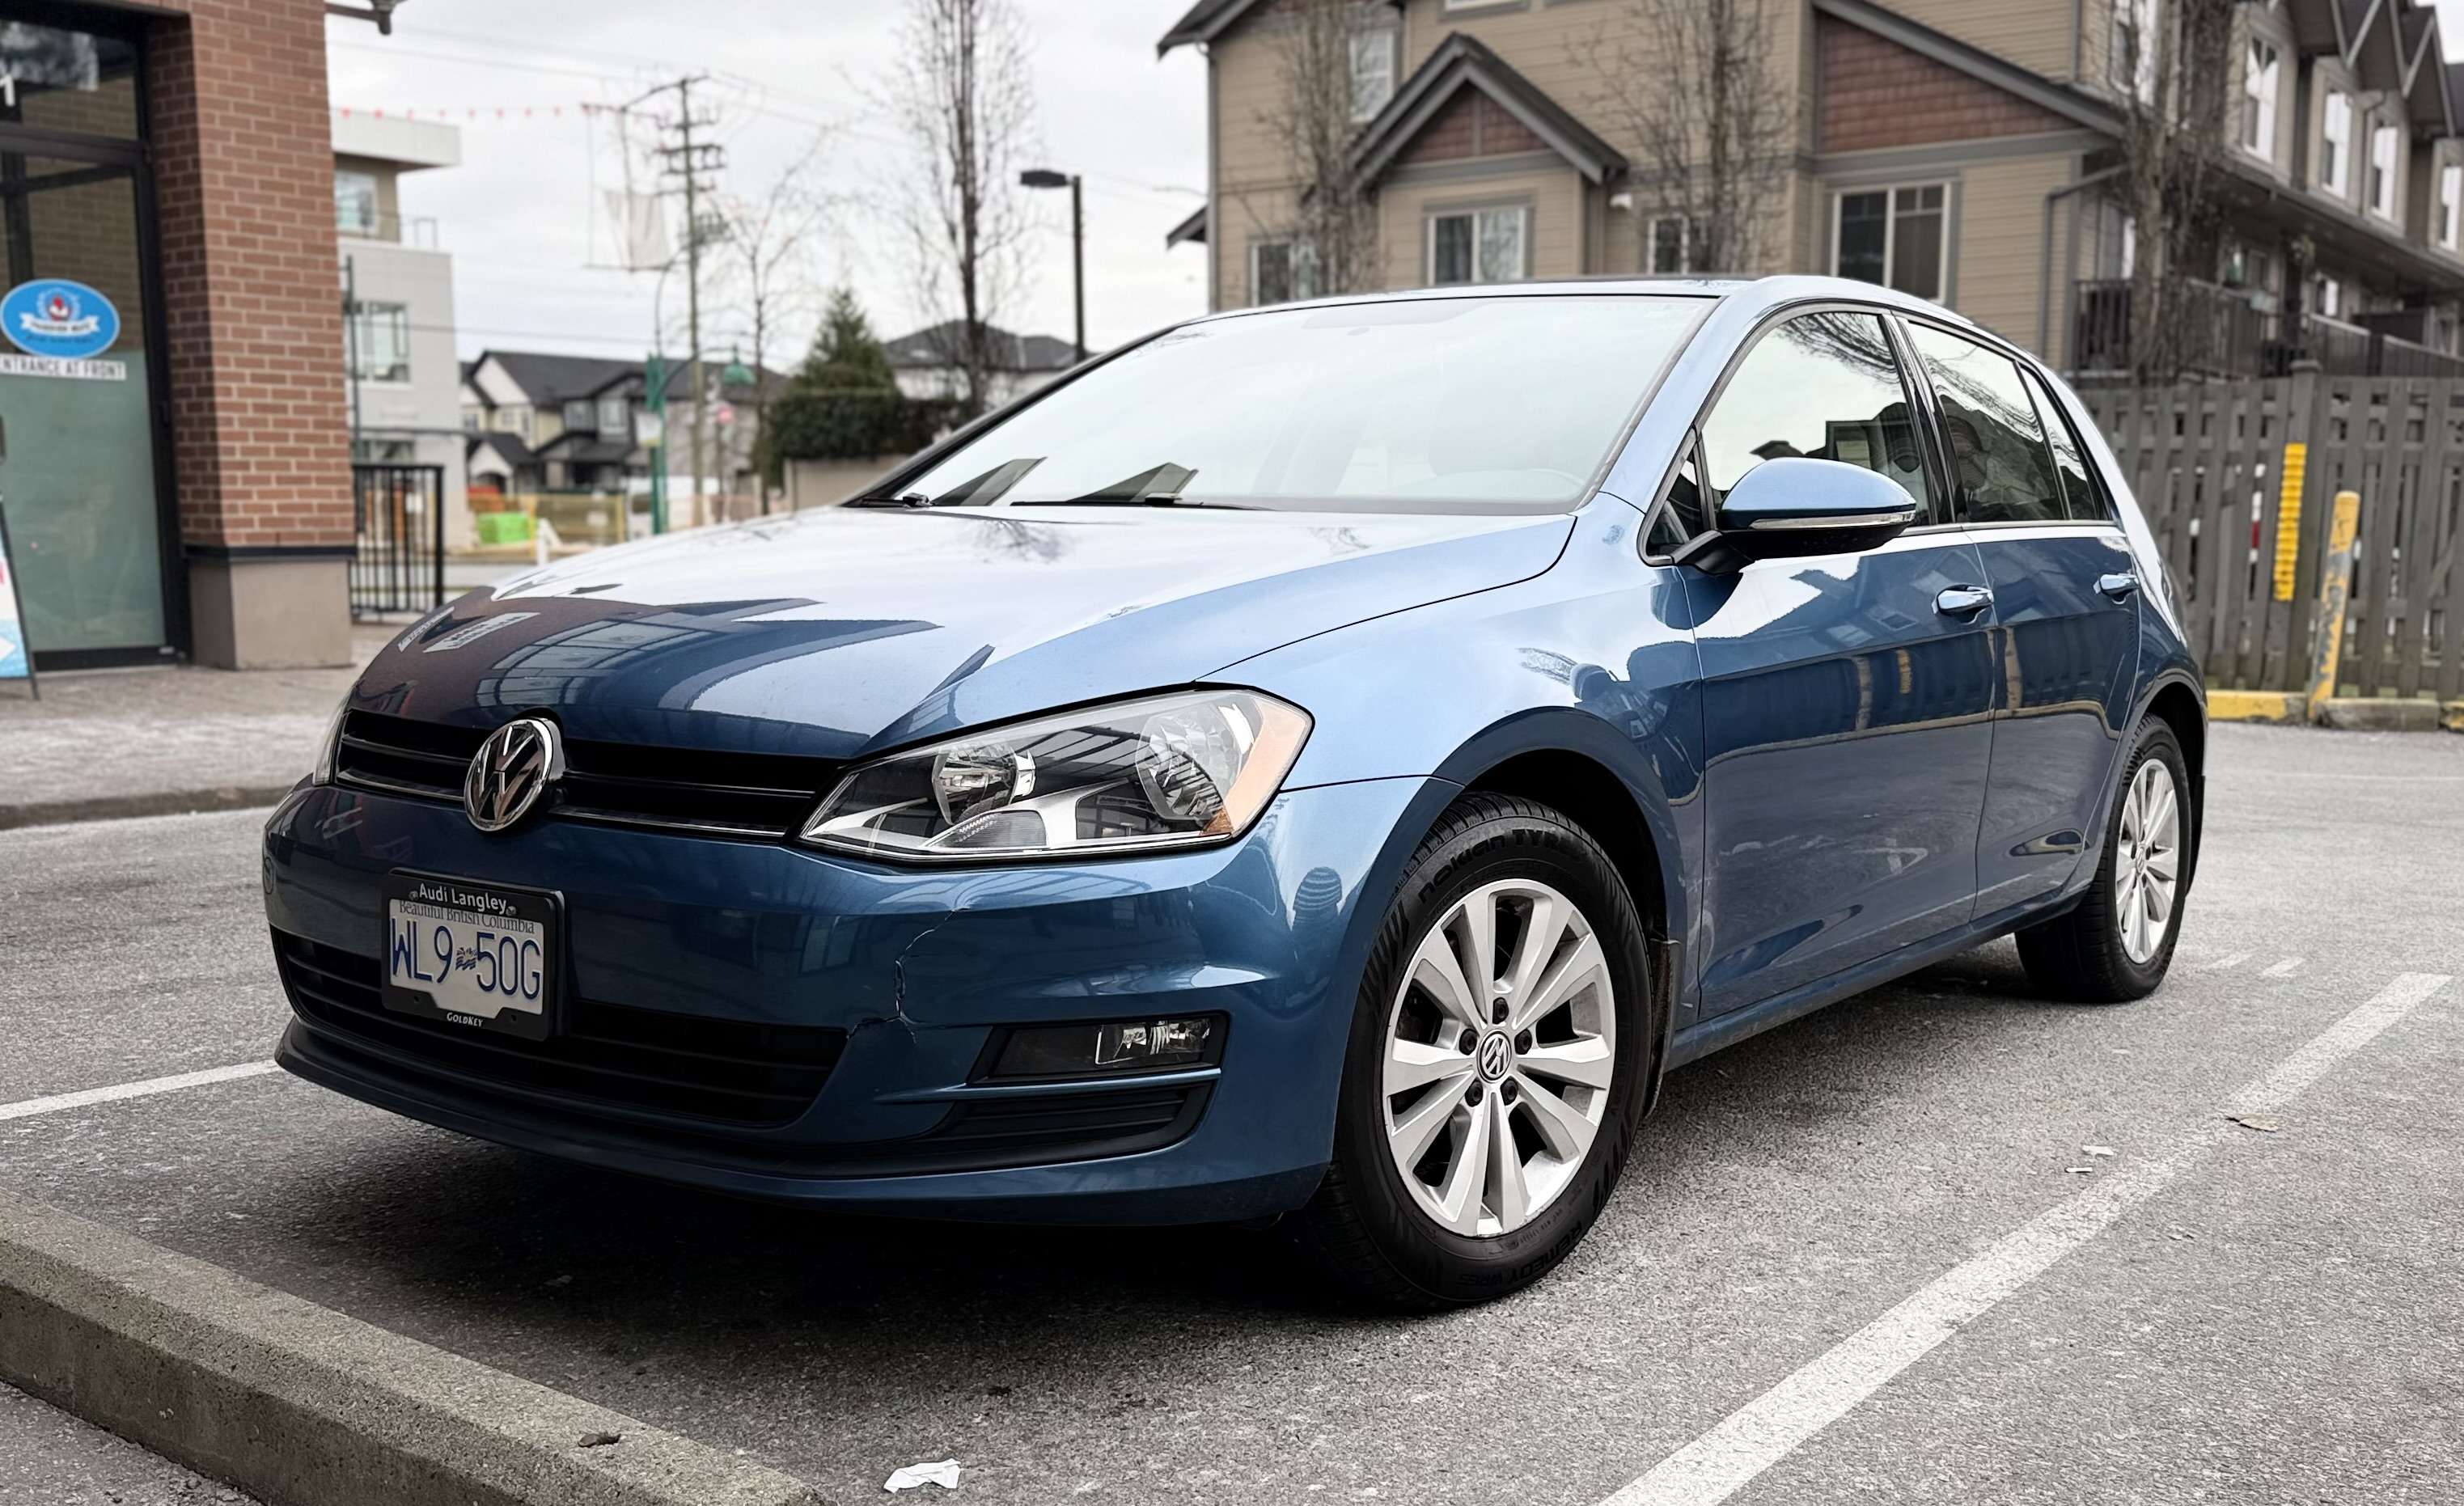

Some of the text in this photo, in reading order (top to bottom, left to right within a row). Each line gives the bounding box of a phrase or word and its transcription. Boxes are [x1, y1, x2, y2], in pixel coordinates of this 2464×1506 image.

[0, 357, 123, 379] NTRANCE AT FRONT
[419, 883, 506, 915] Audi Langley
[447, 908, 480, 926] British
[481, 915, 535, 934] Columbia
